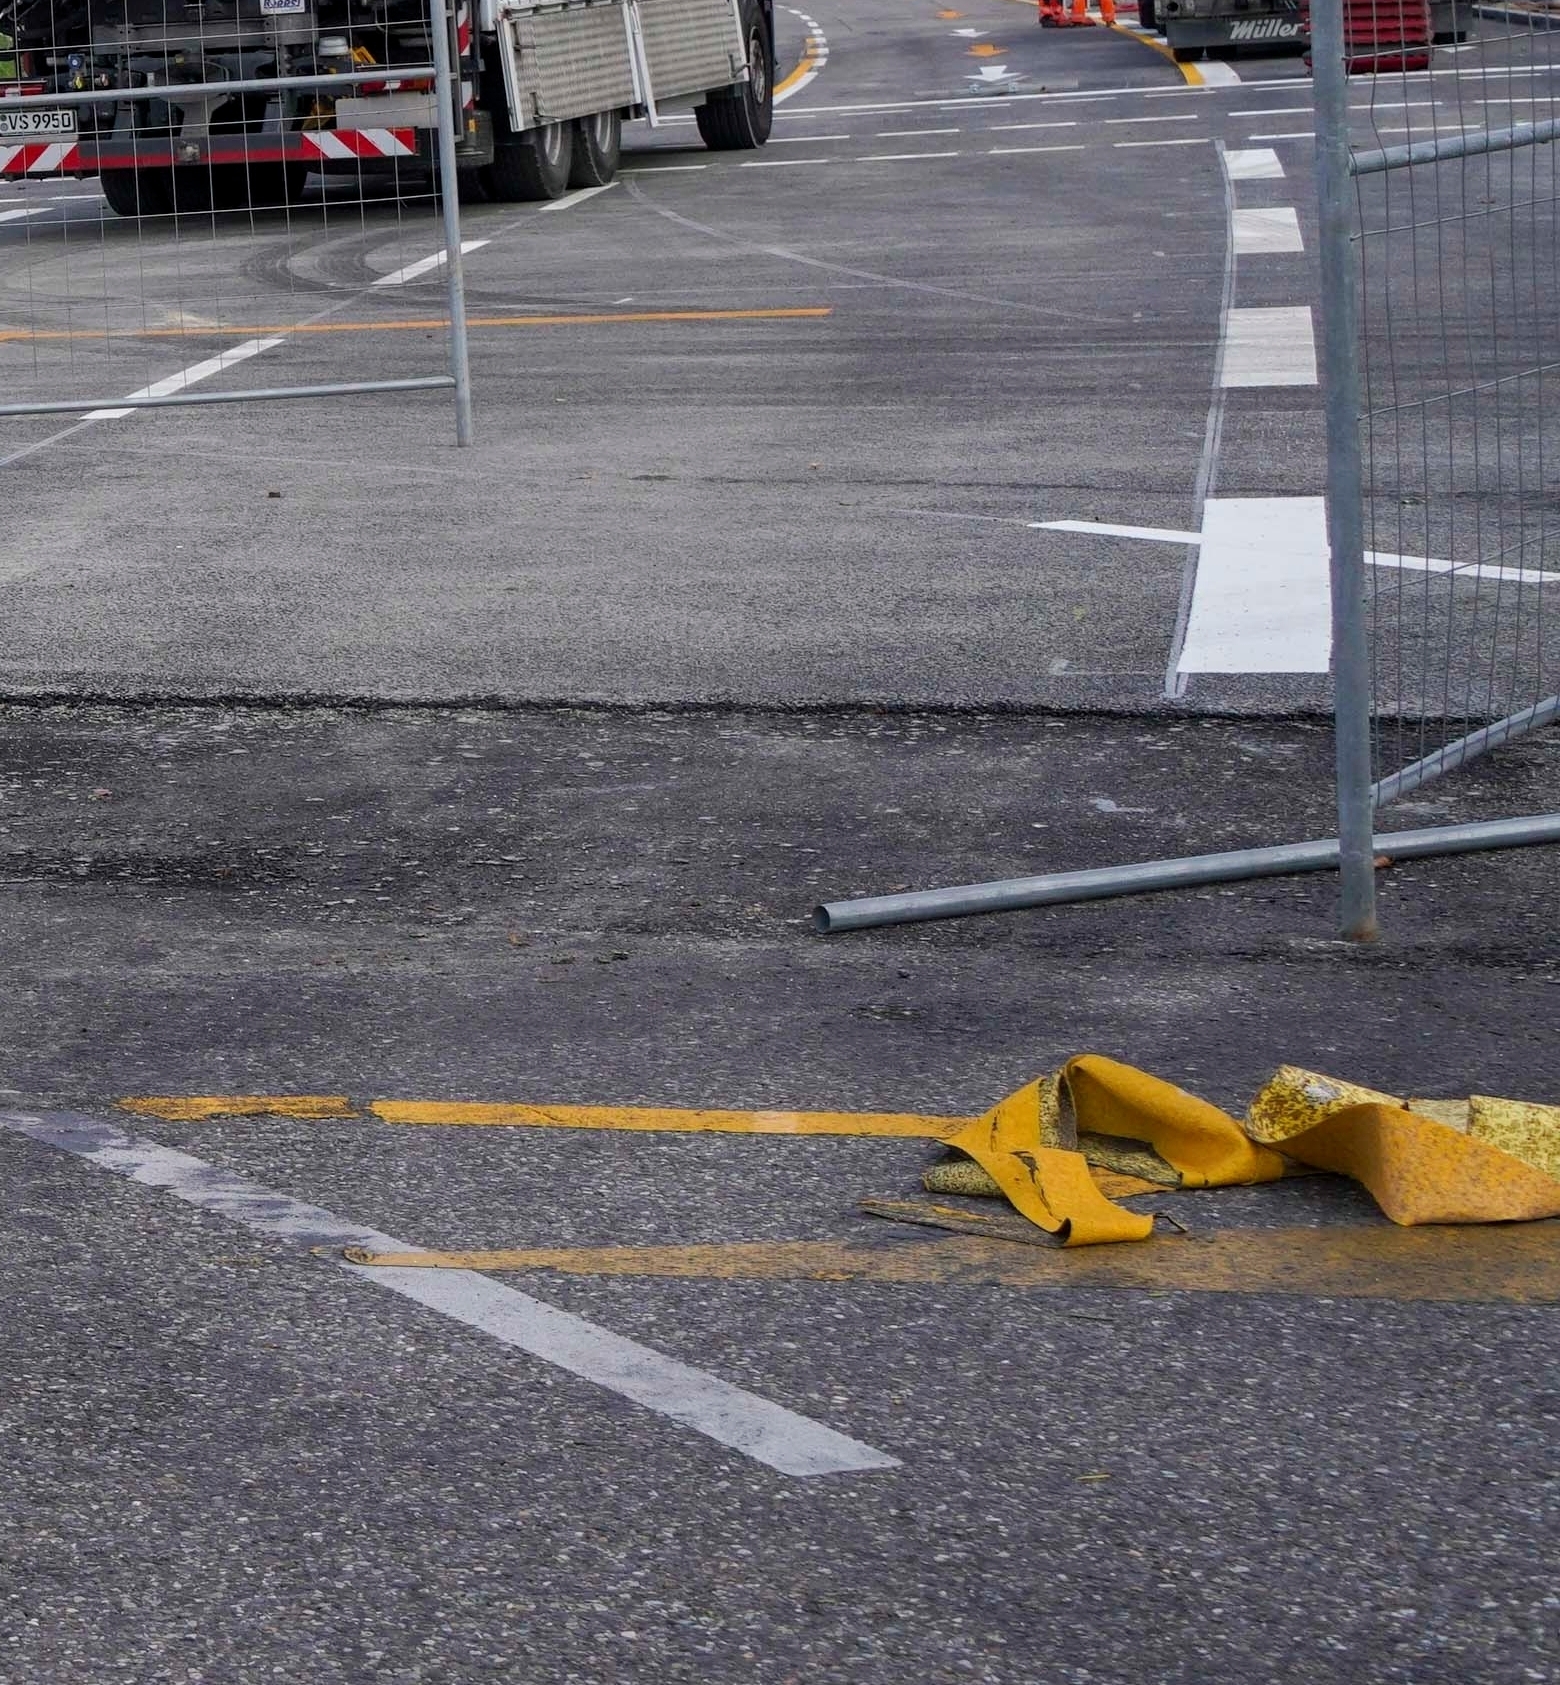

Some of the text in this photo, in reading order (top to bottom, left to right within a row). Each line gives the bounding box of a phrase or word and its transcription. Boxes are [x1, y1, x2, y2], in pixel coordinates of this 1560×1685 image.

[1230, 18, 1304, 40] Müller
[8, 114, 29, 130] VS
[32, 112, 71, 129] 9950
